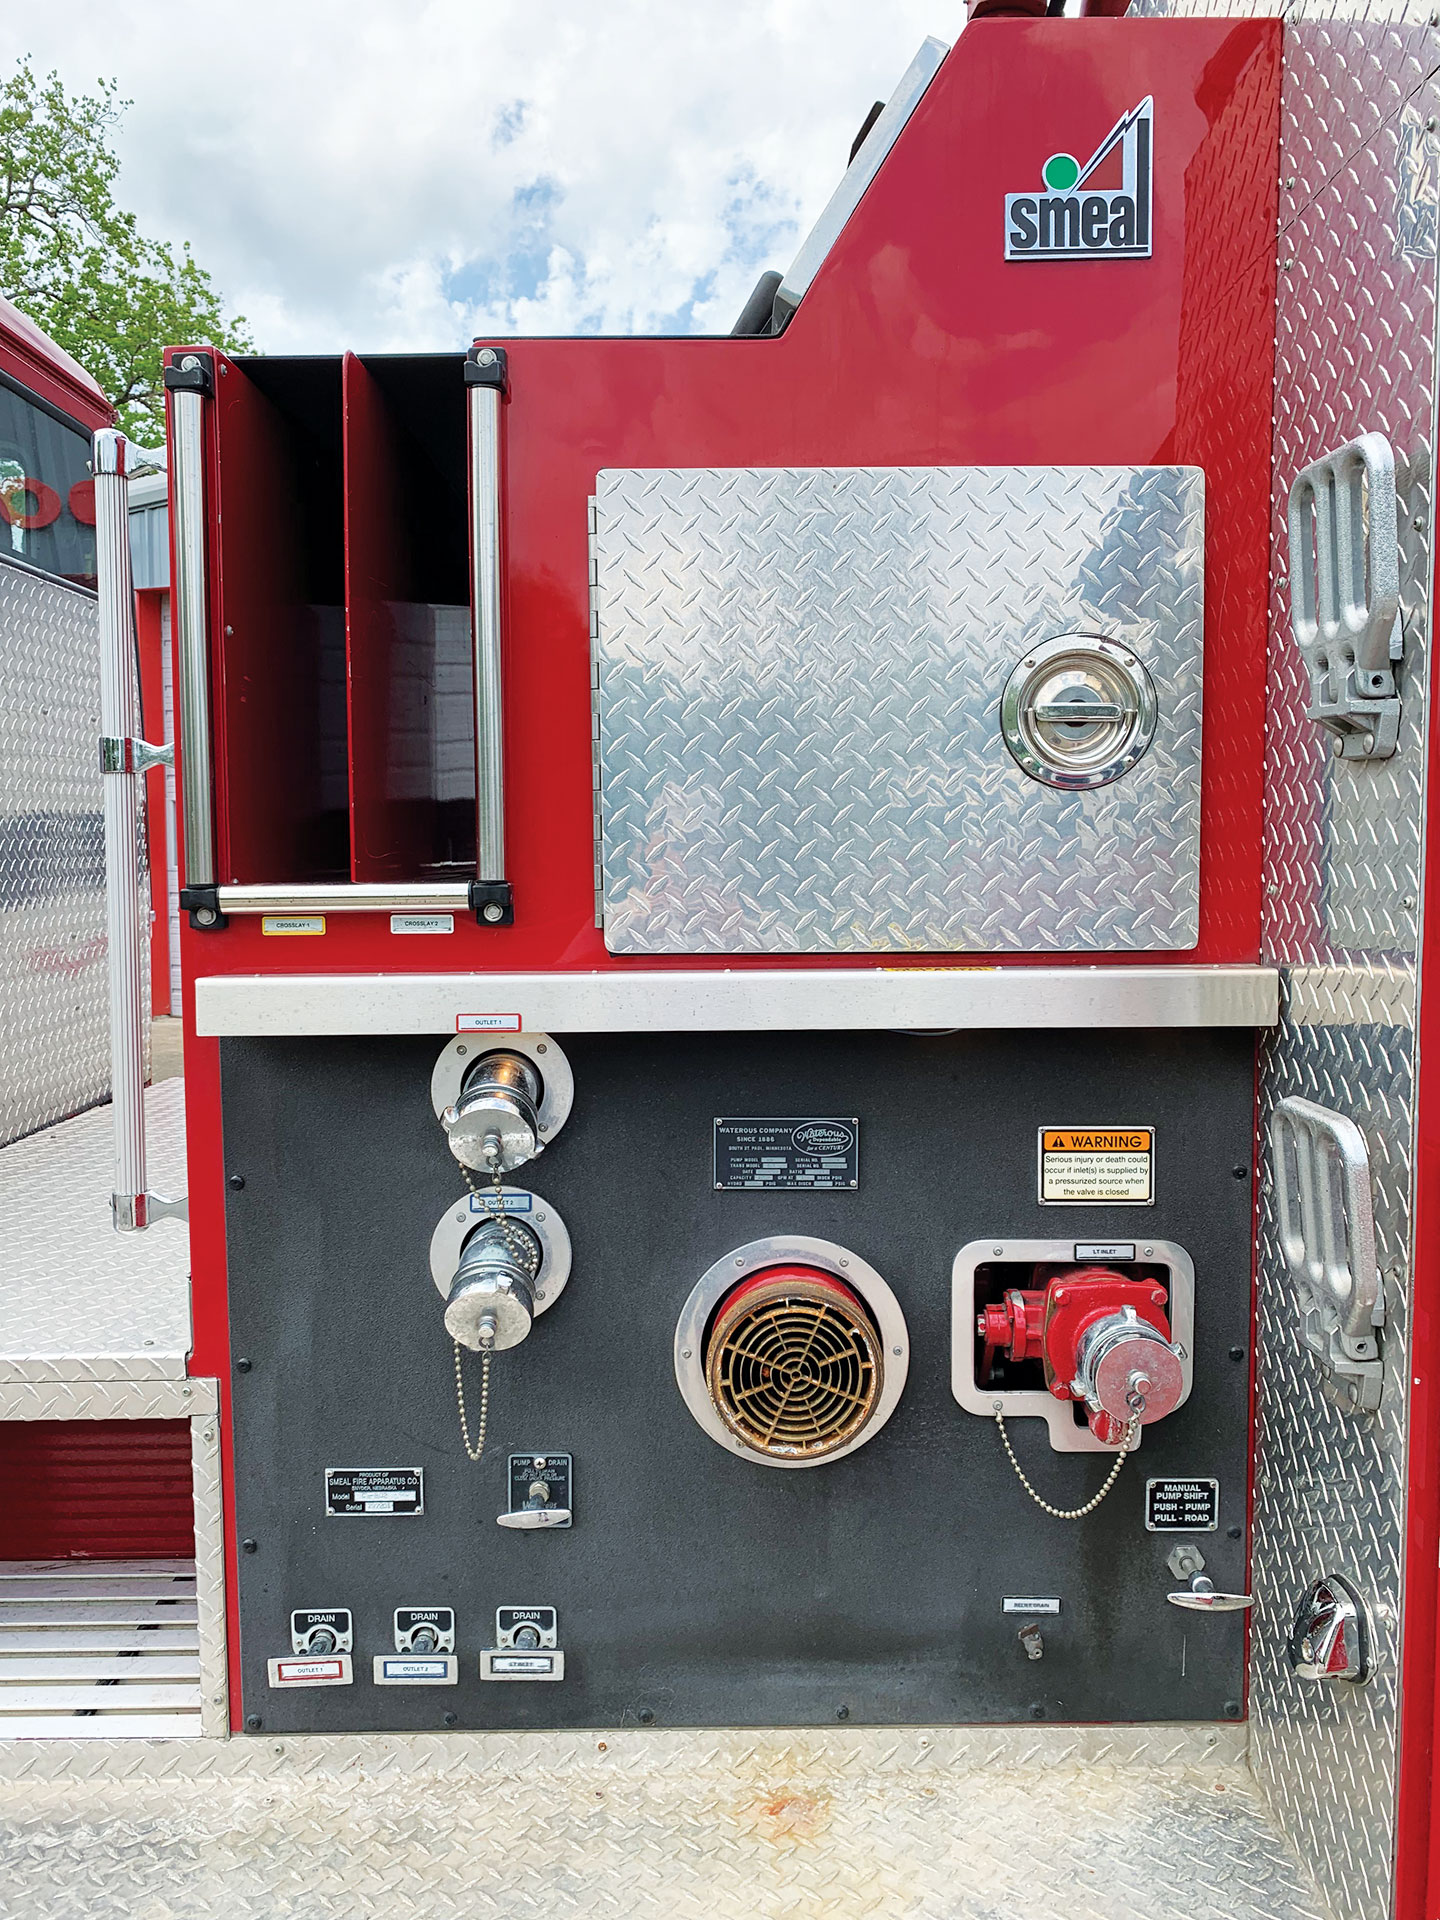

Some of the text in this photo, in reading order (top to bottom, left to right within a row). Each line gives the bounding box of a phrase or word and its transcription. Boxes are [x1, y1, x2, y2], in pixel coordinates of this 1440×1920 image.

[1010, 118, 1150, 248] smeal
[797, 1128, 846, 1142] Waterous
[1071, 1136, 1142, 1148] WARNING
[1075, 1156, 1094, 1164] injury
